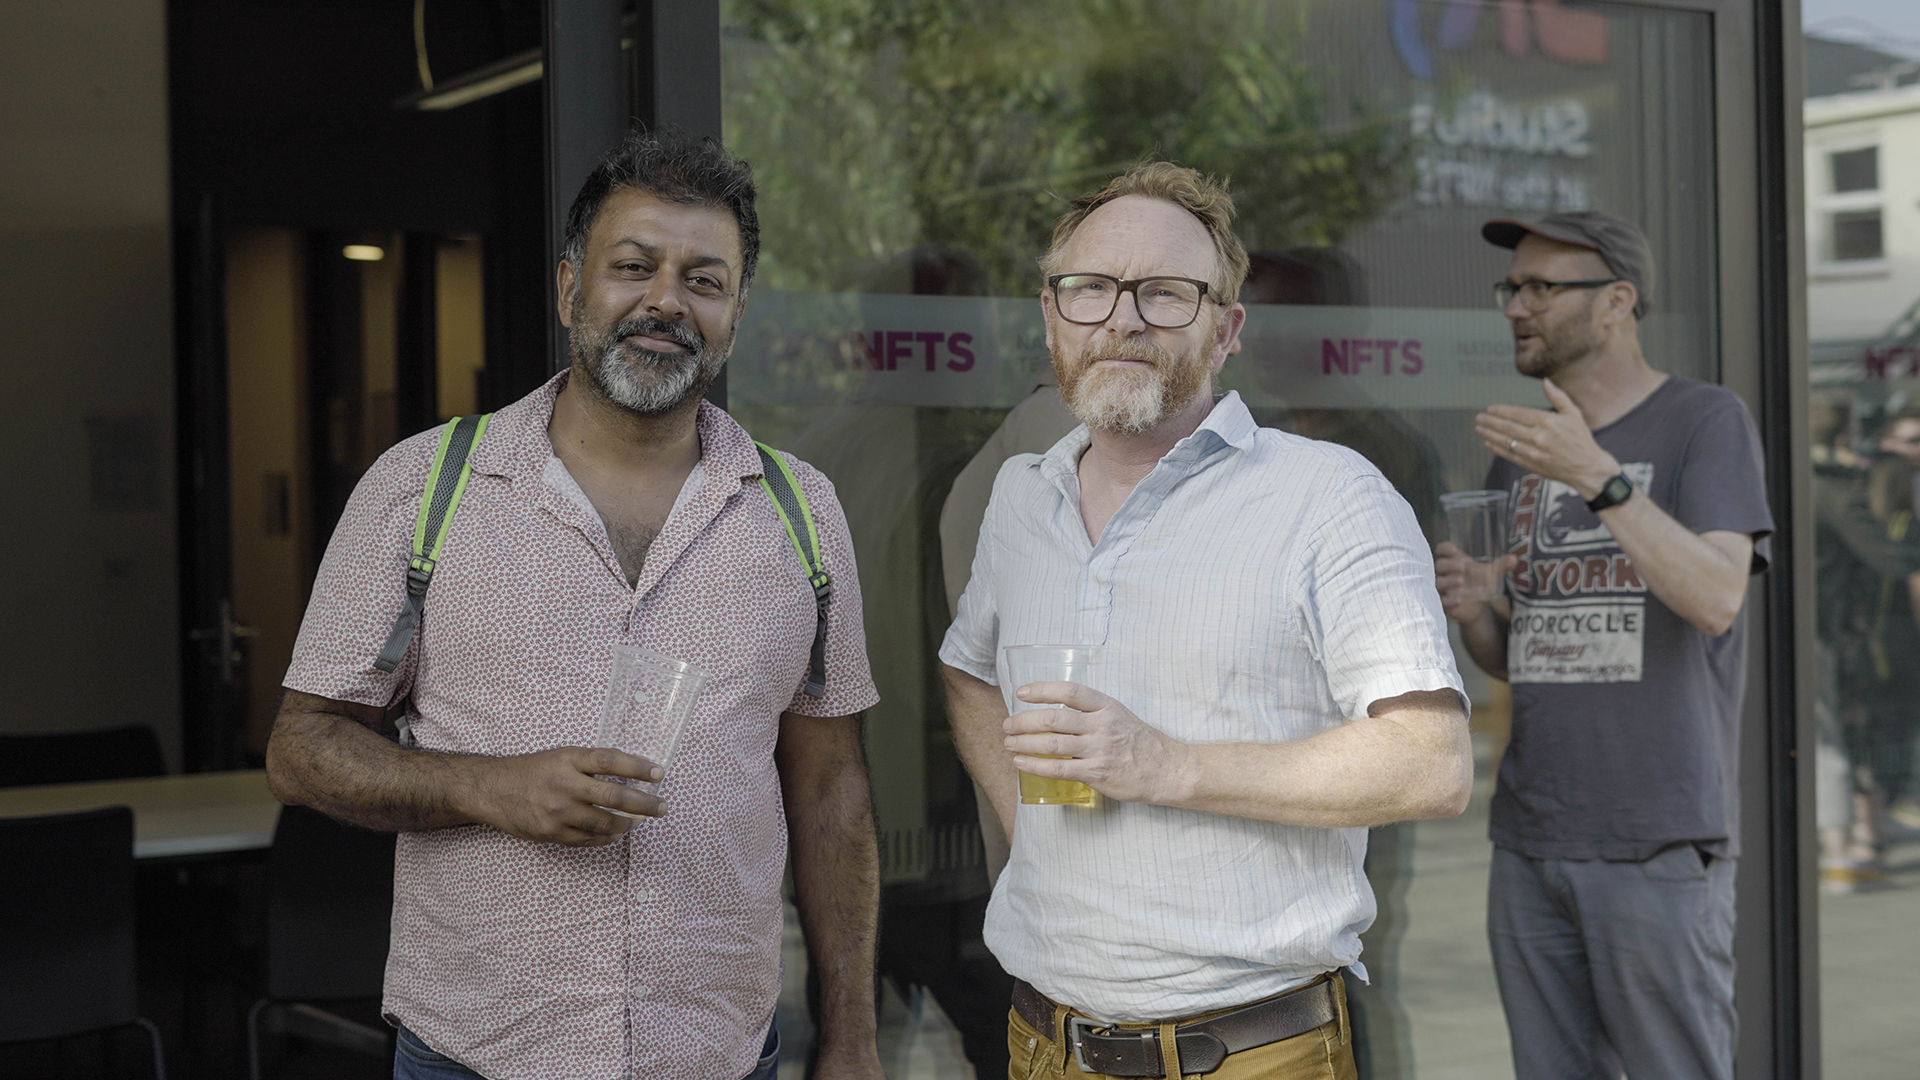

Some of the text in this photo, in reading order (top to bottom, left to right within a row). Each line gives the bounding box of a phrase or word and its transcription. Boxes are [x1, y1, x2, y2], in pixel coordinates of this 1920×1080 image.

[851, 330, 976, 373] NFTS
[1321, 338, 1424, 376] NFTS
[1508, 473, 1543, 592] NEW
[1534, 555, 1647, 595] YORK
[1508, 612, 1638, 636] OTORCYCLE
